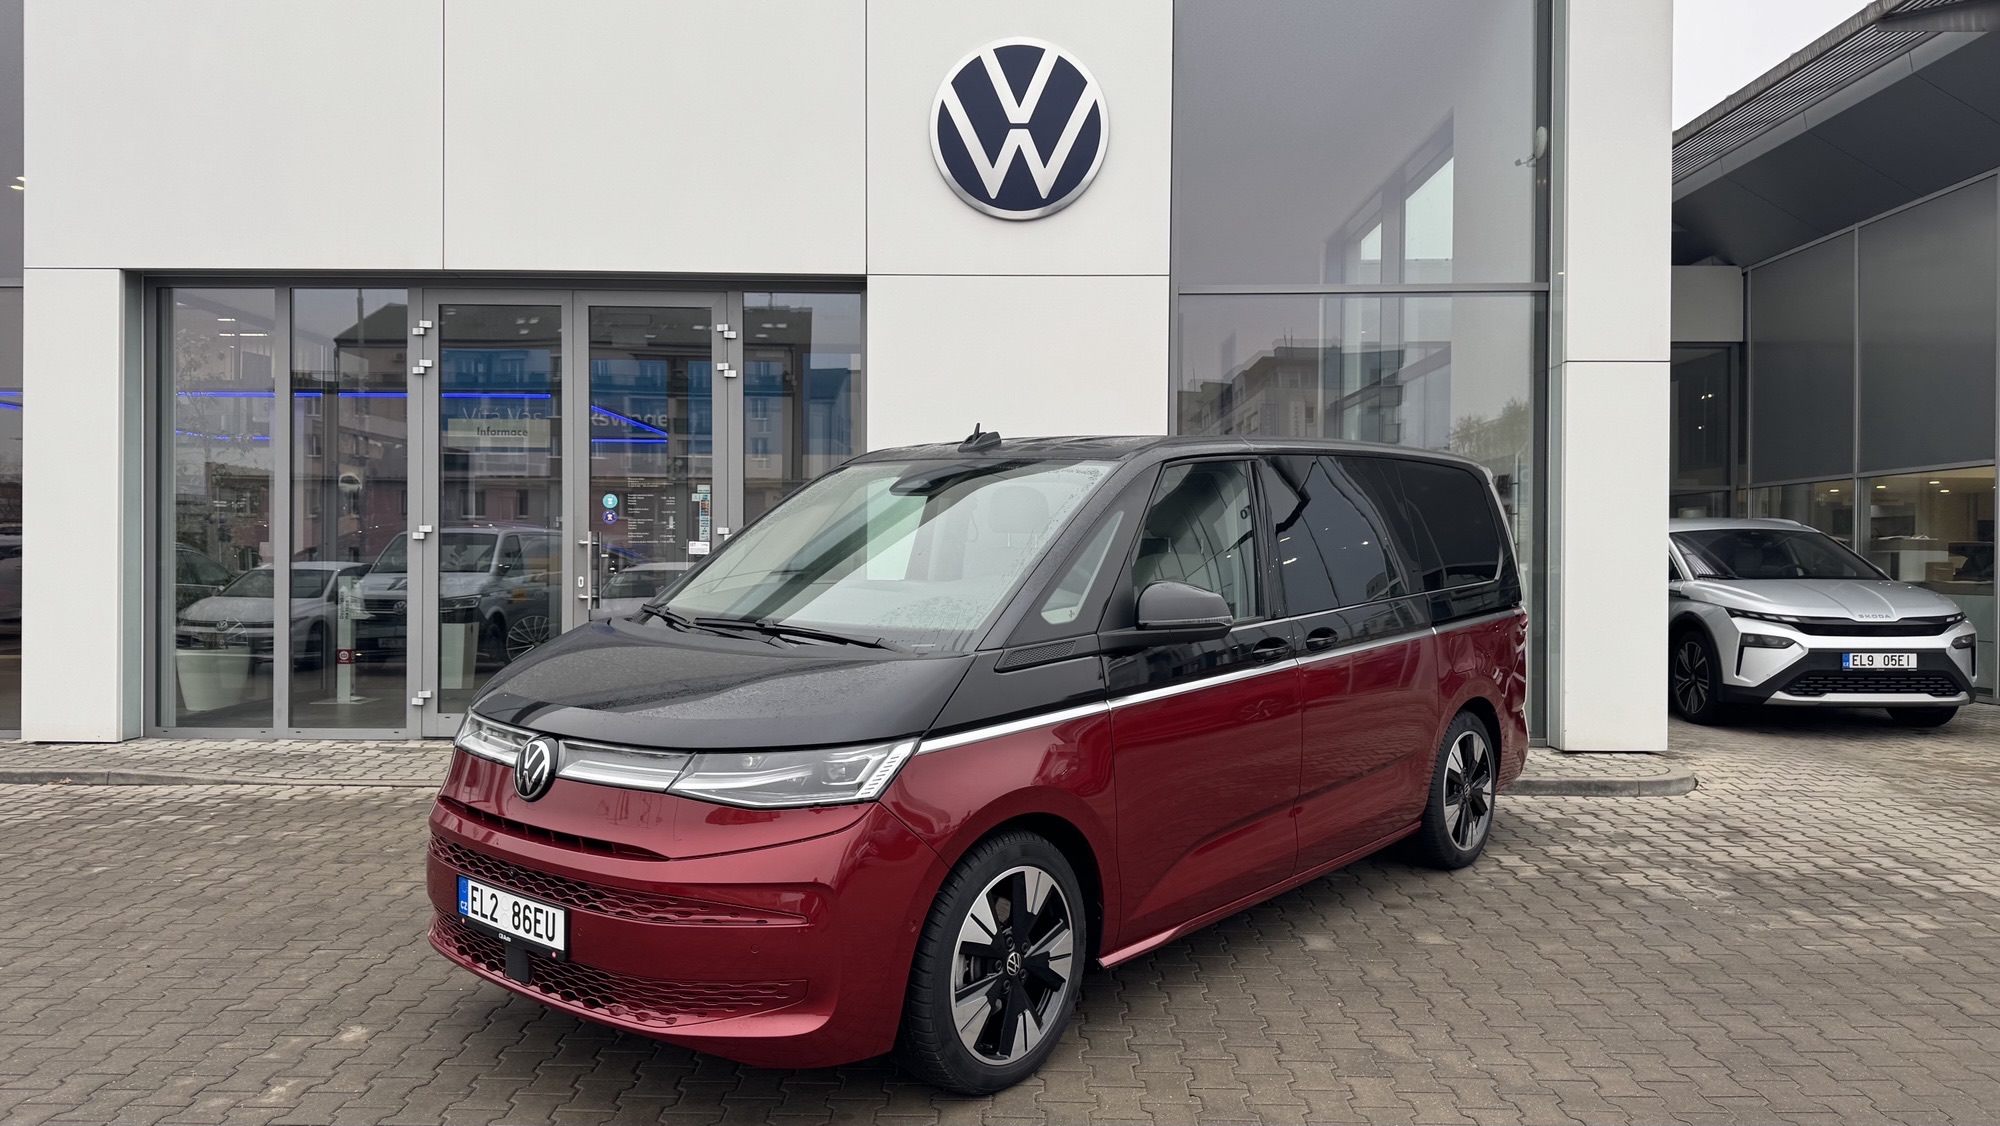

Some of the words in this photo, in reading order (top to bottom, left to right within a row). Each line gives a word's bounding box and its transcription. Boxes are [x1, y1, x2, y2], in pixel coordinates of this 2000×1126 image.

[930, 37, 1109, 222] VW
[476, 426, 529, 437] Informace
[1852, 654, 1874, 667] EL9
[1883, 654, 1910, 667] 05EI
[460, 900, 468, 911] CZ
[471, 885, 499, 924] EL2
[511, 900, 556, 942] 86EU
